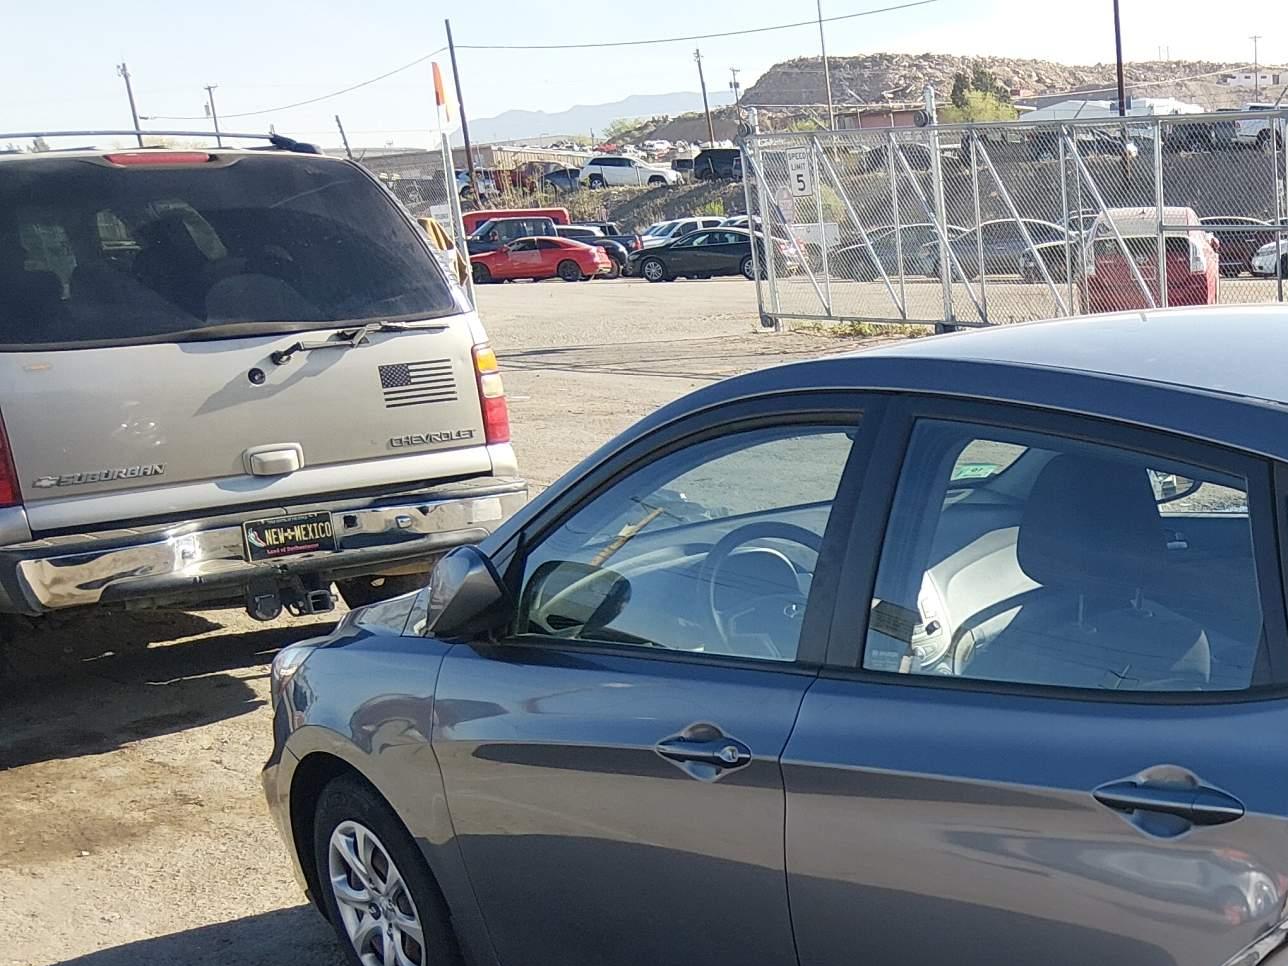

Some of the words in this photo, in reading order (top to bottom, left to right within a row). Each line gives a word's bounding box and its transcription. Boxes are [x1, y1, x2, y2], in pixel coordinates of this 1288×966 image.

[787, 152, 806, 160] SPEED
[791, 162, 806, 171] LIMIT
[796, 173, 806, 191] 5
[390, 429, 475, 448] CHEVROLET
[57, 465, 165, 487] SUBURBAN
[264, 527, 286, 546] NEW
[294, 522, 332, 542] MEXICO
